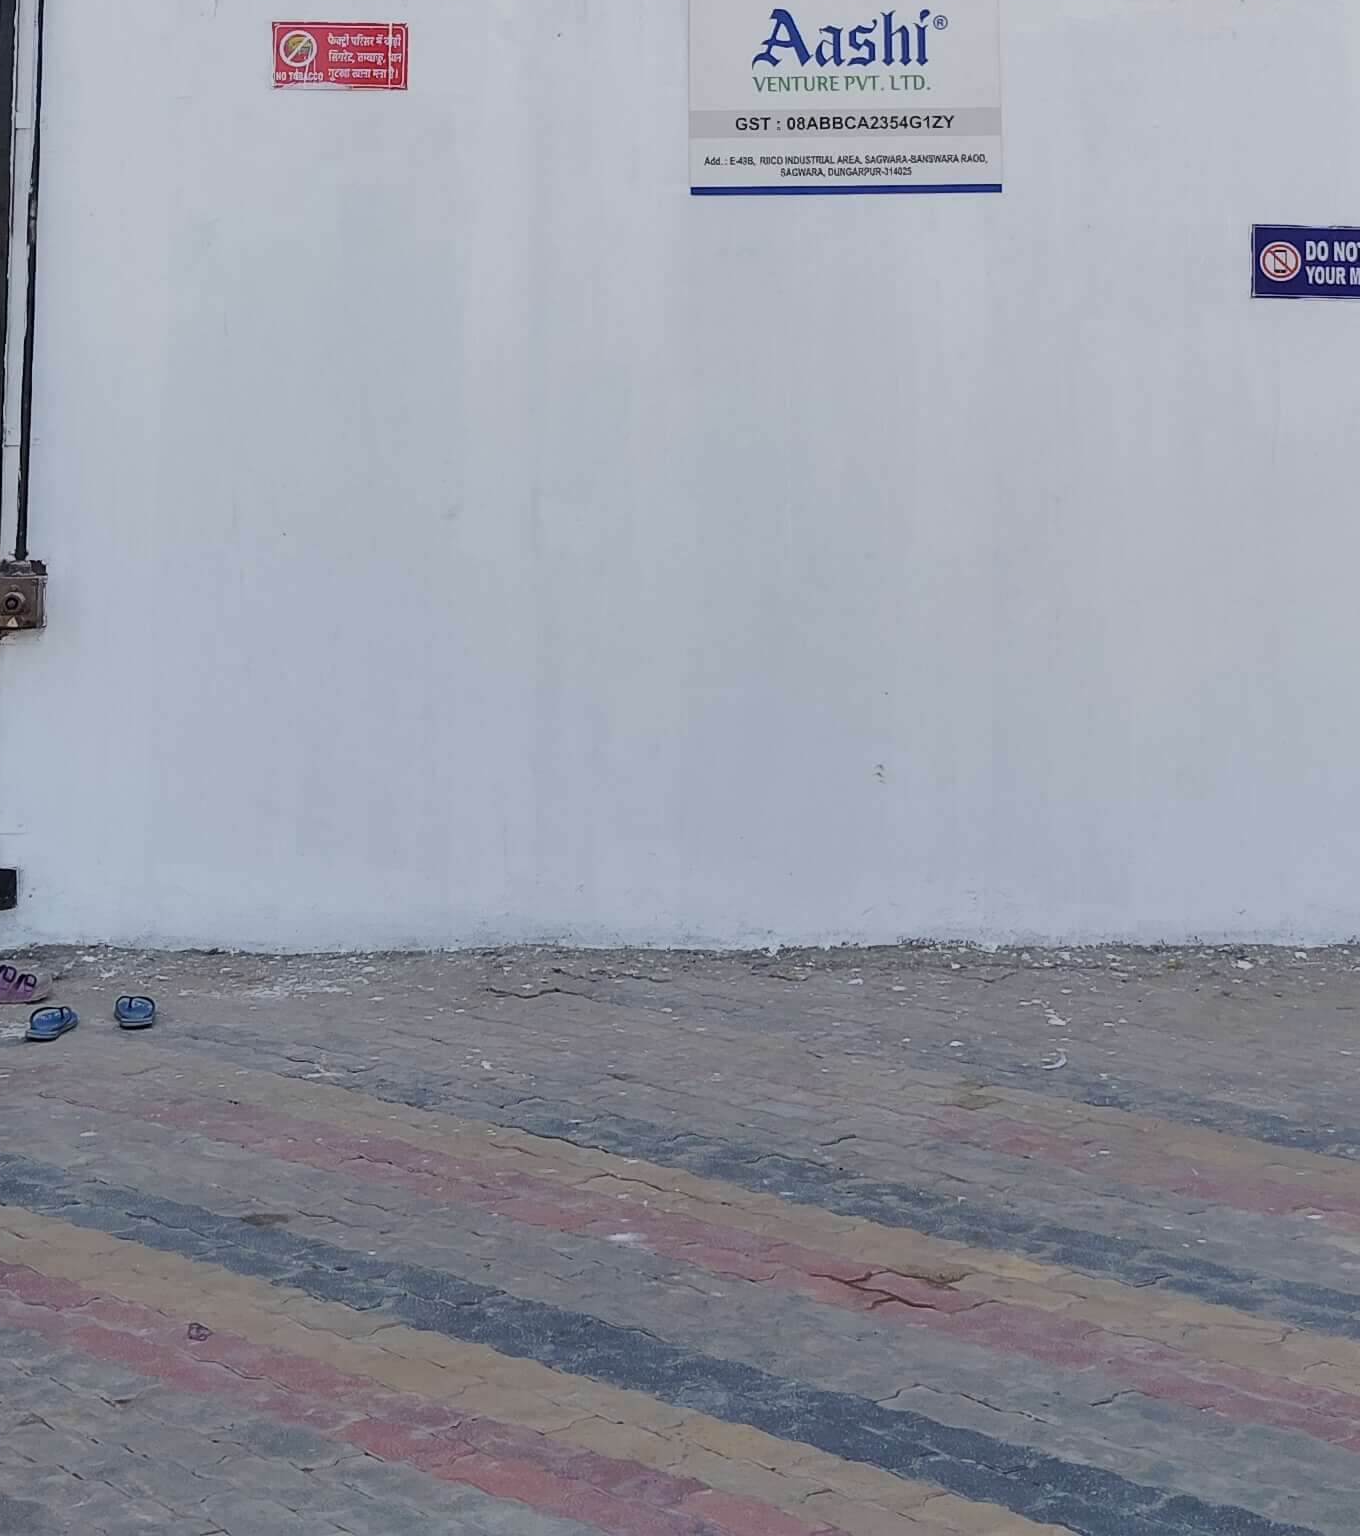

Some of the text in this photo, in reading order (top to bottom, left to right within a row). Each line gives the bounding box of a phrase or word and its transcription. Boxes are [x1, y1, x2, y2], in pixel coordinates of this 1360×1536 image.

[275, 71, 287, 81] NO
[752, 74, 931, 93] VENTURE PVT. LTD.
[735, 117, 771, 132] GST
[786, 114, 955, 131] 08ABBCA2354G1ZY
[785, 155, 835, 165] INDUSTRIAL
[1305, 240, 1329, 262] DO
[1305, 265, 1347, 286] YOUR
